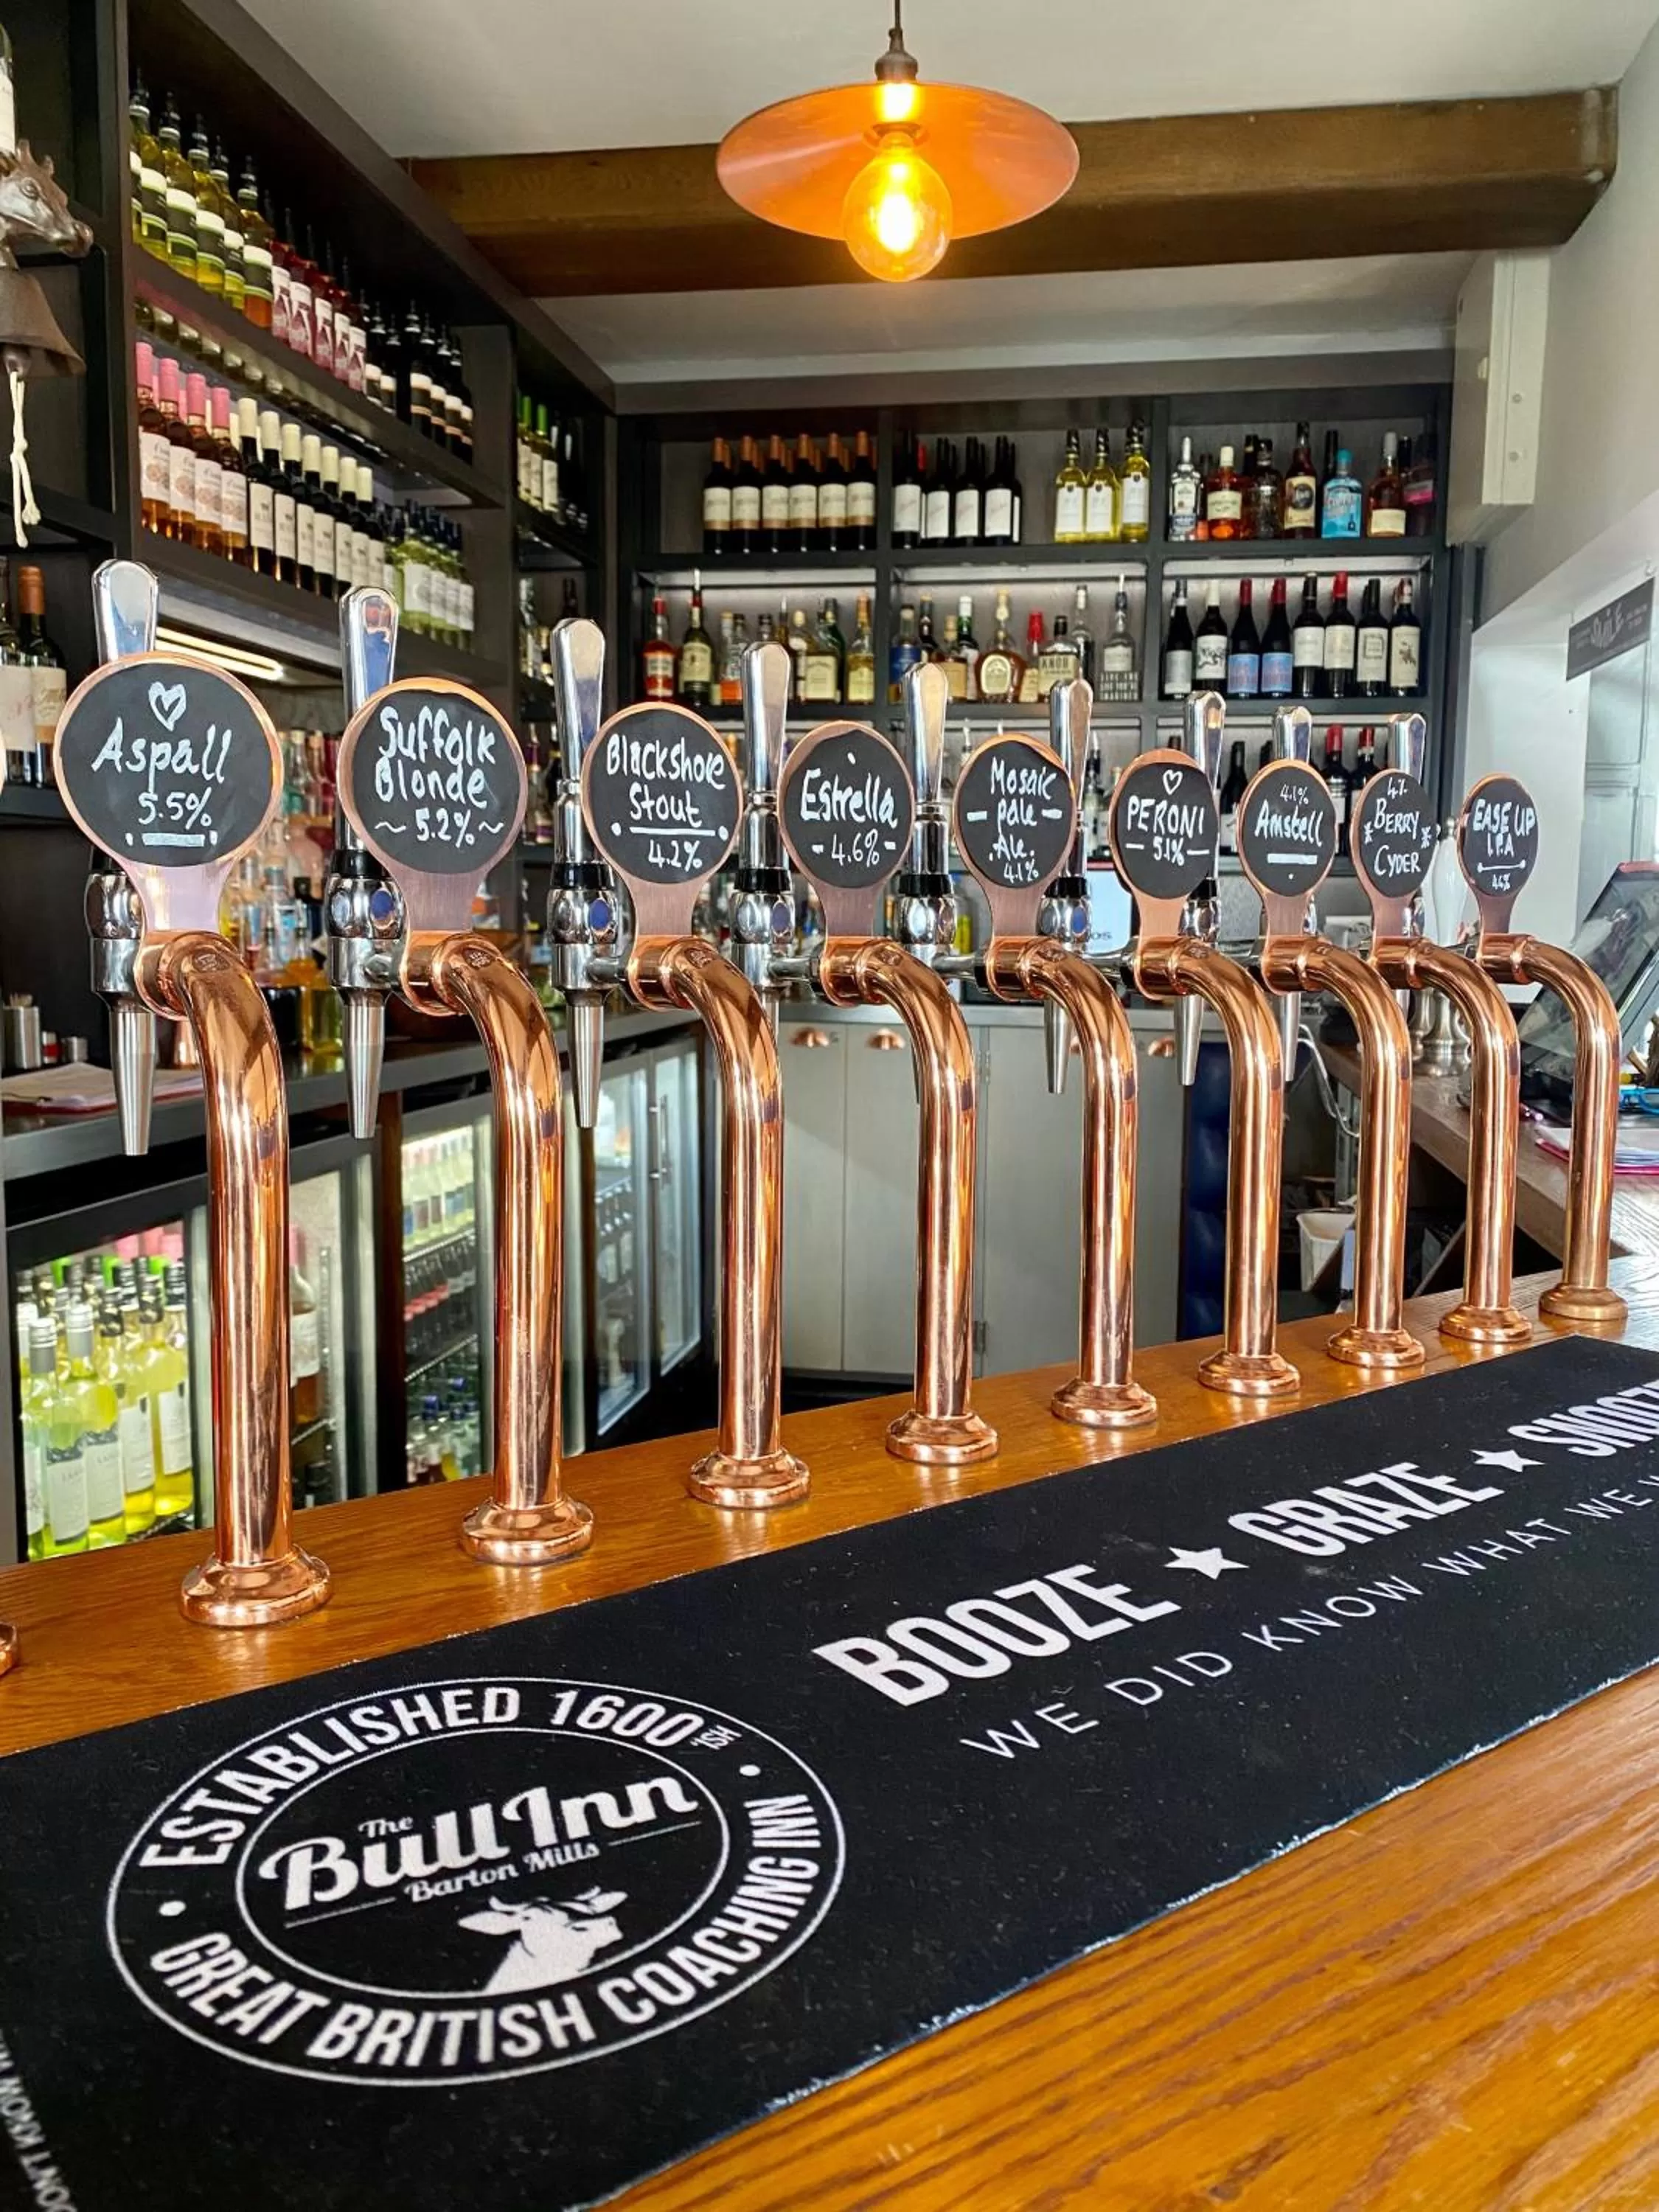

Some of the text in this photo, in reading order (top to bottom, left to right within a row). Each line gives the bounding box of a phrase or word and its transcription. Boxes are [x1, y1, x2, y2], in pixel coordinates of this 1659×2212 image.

[91, 717, 232, 794] Aspall
[378, 705, 496, 766] Suffolk
[375, 756, 489, 809] Blonde
[605, 734, 727, 790] Blackshore
[990, 757, 1057, 800] Mosaic
[137, 787, 213, 830] 5.5%
[629, 782, 703, 829] Stout
[800, 768, 898, 829] Estrella
[1127, 795, 1205, 838] PERONI
[1280, 784, 1309, 805] 4.1%
[1472, 799, 1536, 837] EASE UP
[414, 807, 476, 847] 5.2%
[830, 829, 880, 867] 4.6%
[648, 840, 703, 873] 4.2%
[1004, 858, 1039, 884] 4.1%
[811, 1378, 1659, 1707] BOOZE GRAZE SNOOZ
[960, 1489, 1653, 1759] WE DID KNOW WHAT WE
[139, 1686, 520, 1867] ESTABLISHED
[358, 1816, 414, 1837] The
[404, 1842, 600, 1903] Barton Mills
[150, 1794, 821, 2067] GREAT BRITISH COACHING INN
